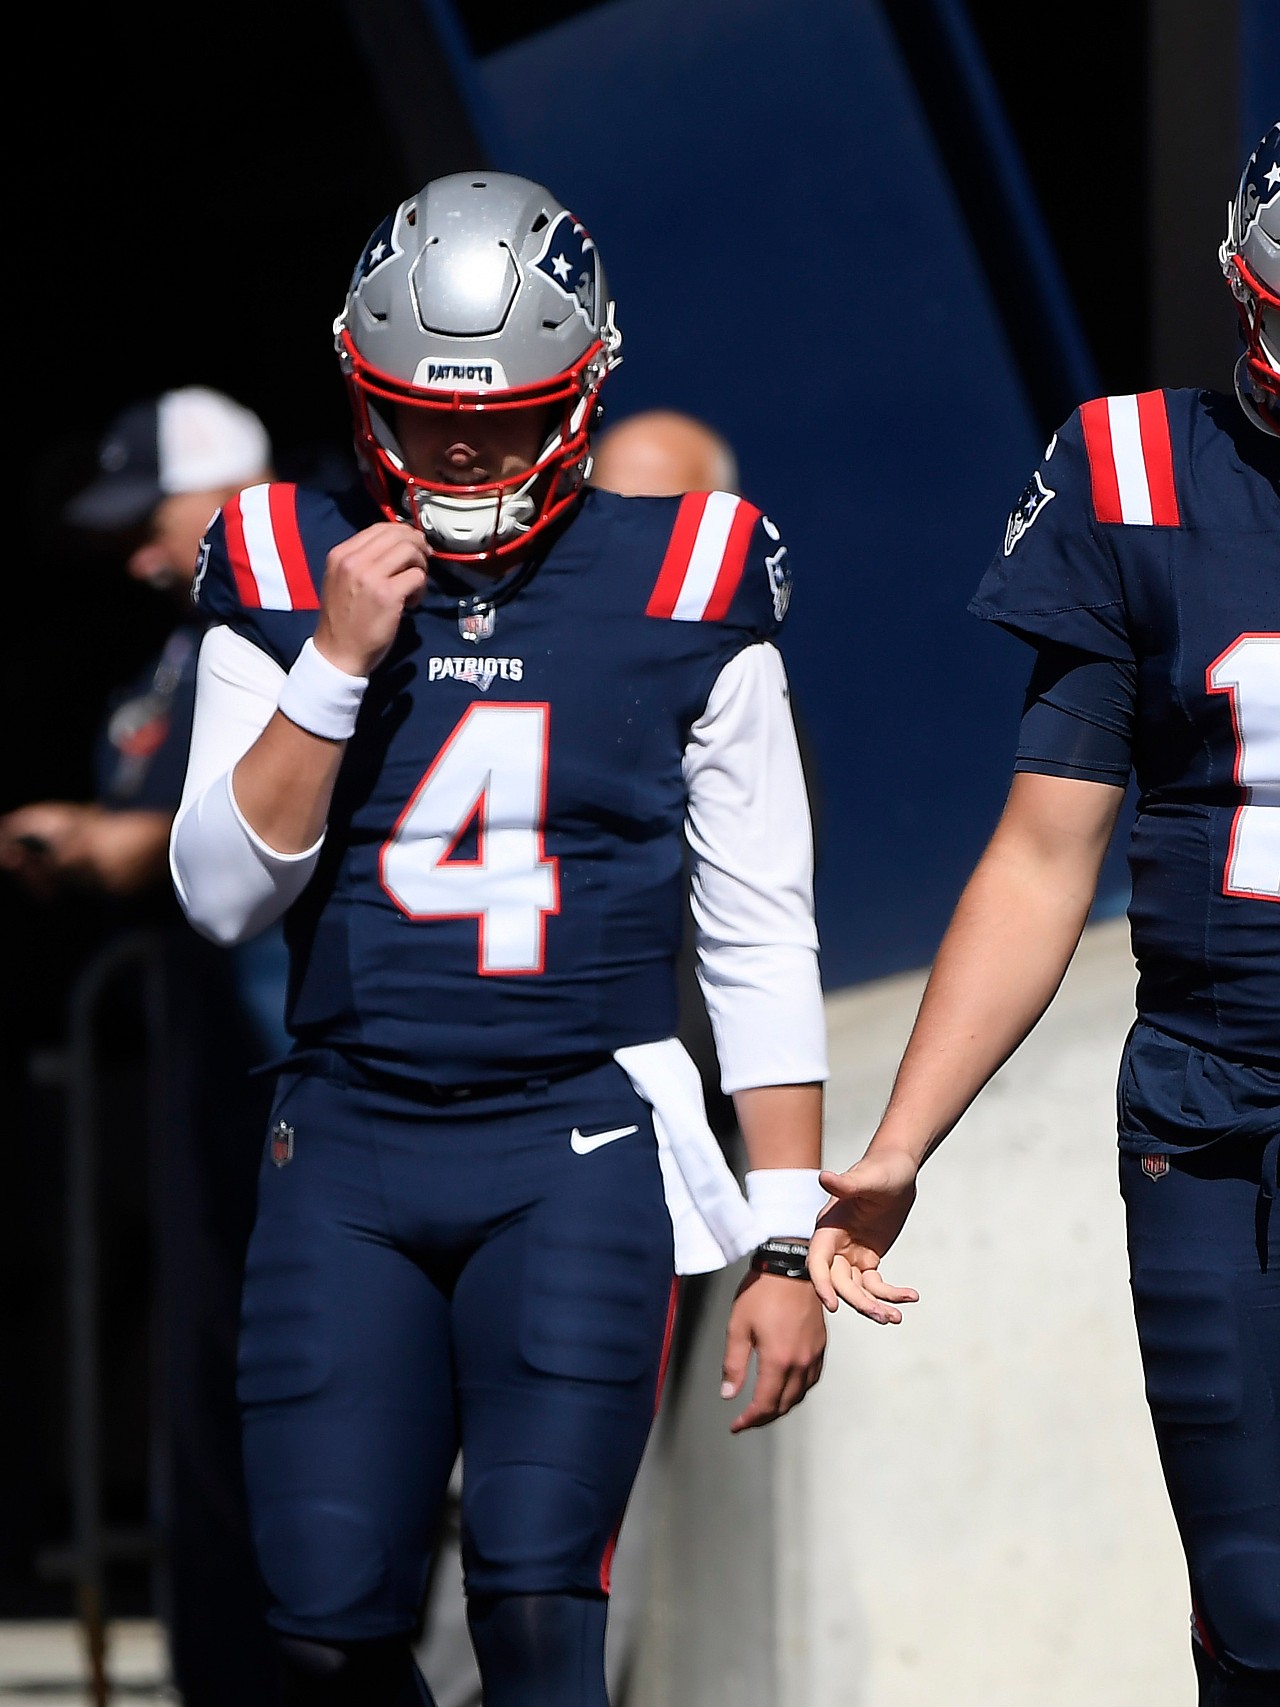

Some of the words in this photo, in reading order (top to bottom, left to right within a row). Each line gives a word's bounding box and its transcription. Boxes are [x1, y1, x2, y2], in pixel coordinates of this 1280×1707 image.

[427, 364, 492, 384] PATRIOTS
[429, 657, 523, 681] PATRIOTS
[378, 700, 560, 976] 4
